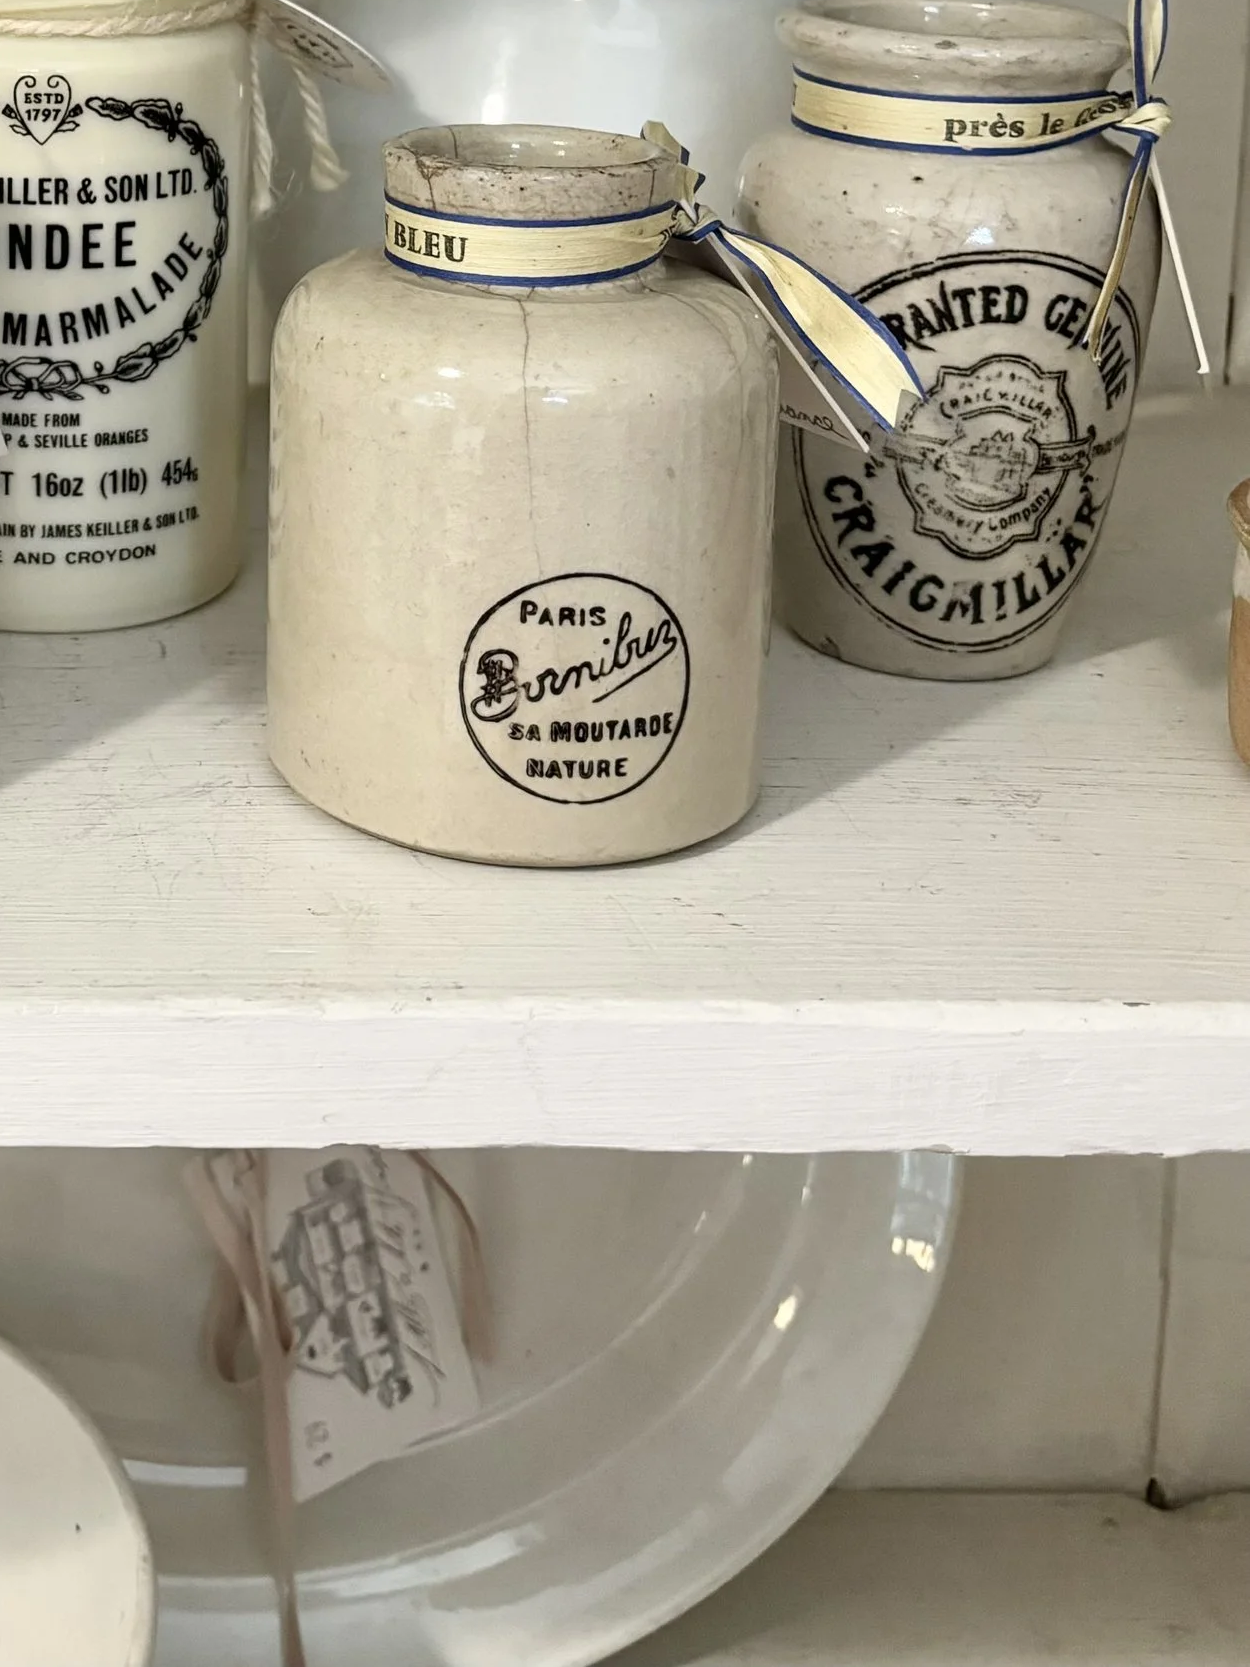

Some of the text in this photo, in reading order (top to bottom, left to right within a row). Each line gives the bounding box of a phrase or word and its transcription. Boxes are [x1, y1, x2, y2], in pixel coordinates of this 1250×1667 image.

[24, 93, 65, 104] ESTD
[25, 108, 62, 122] 1797
[943, 112, 1025, 142] près
[1040, 112, 1064, 137] le
[77, 177, 97, 205] &
[104, 173, 148, 203] SON
[156, 168, 198, 199] LTD.
[393, 219, 469, 263] BLEU
[2, 232, 204, 347] MARMALADE
[2, 412, 81, 428] MADE FROM
[17, 434, 29, 448] &
[34, 434, 88, 448] SEVILLE
[94, 428, 149, 447] ORANGES
[31, 471, 84, 498] 16oz
[100, 467, 148, 500] (1lb)
[20, 524, 36, 538] BY
[41, 524, 82, 539] JAMES
[86, 519, 139, 537] KEILLER
[142, 517, 152, 531] &
[156, 512, 176, 529] SON
[13, 551, 56, 565] AND
[64, 544, 157, 565] CROYDON
[519, 600, 607, 627] PARIS
[507, 711, 674, 743] SA MOUTARDE
[525, 757, 629, 779] NATURE
